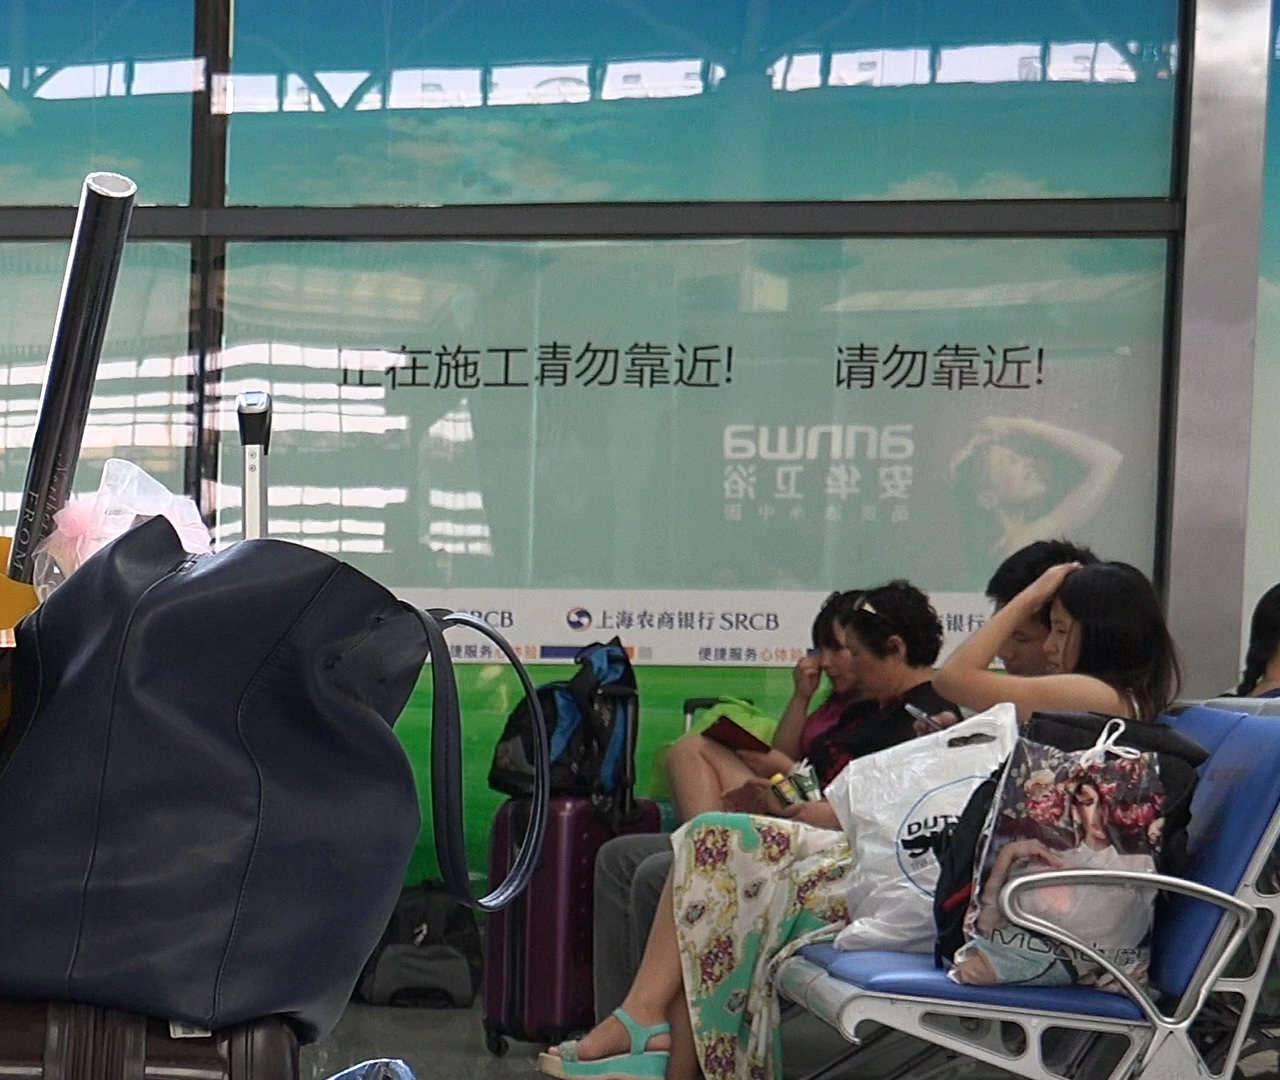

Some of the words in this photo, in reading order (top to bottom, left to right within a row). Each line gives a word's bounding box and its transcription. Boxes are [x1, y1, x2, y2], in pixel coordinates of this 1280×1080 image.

[835, 343, 1044, 390] 请勿靠近!
[595, 606, 715, 631] 上海农商银行
[719, 612, 780, 631] SRCB
